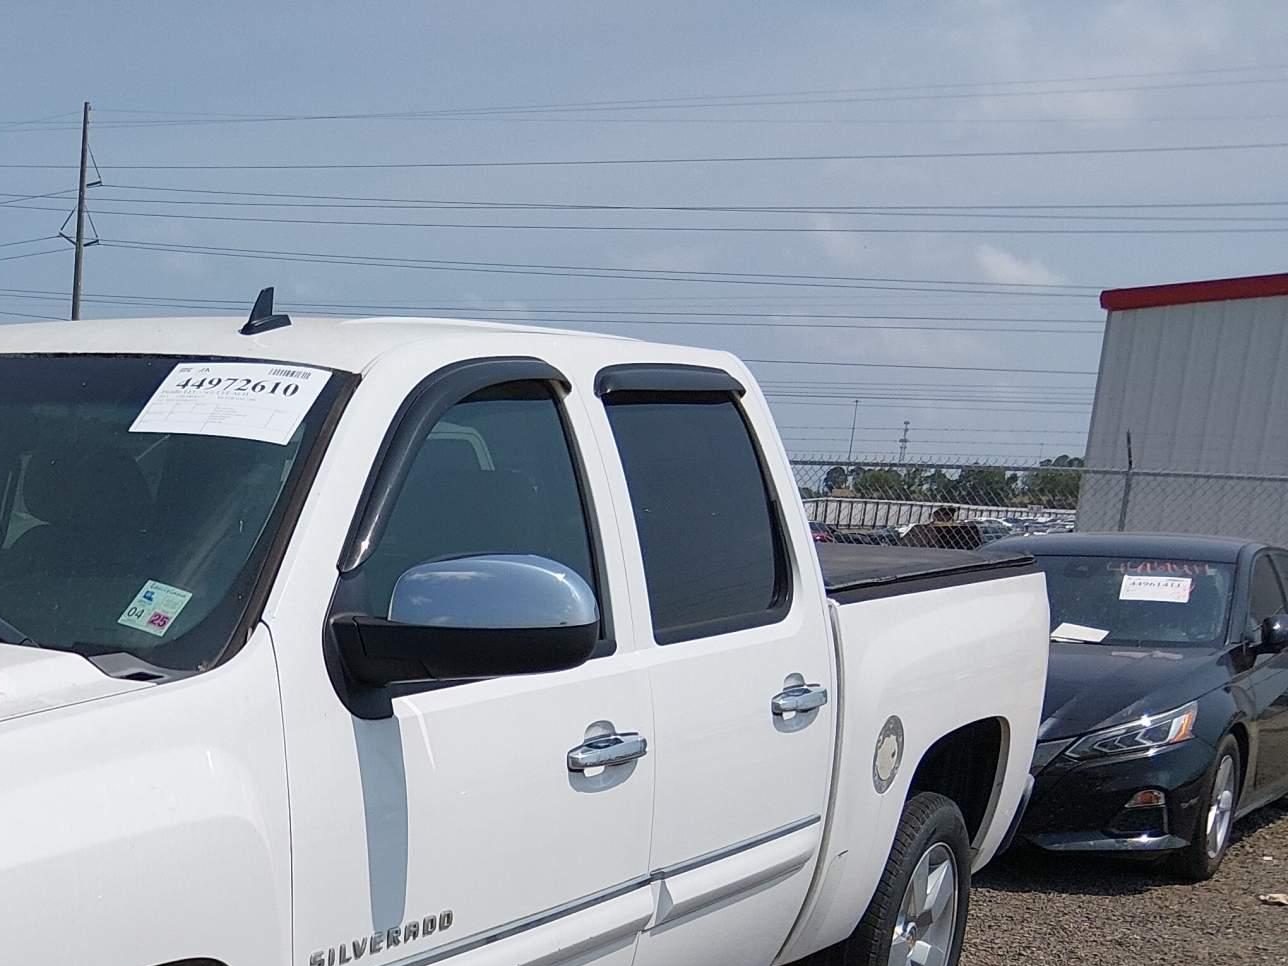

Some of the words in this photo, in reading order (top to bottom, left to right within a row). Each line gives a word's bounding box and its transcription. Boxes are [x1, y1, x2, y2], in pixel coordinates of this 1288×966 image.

[176, 377, 299, 397] 44972610
[127, 606, 144, 620] 04
[151, 613, 169, 627] 25
